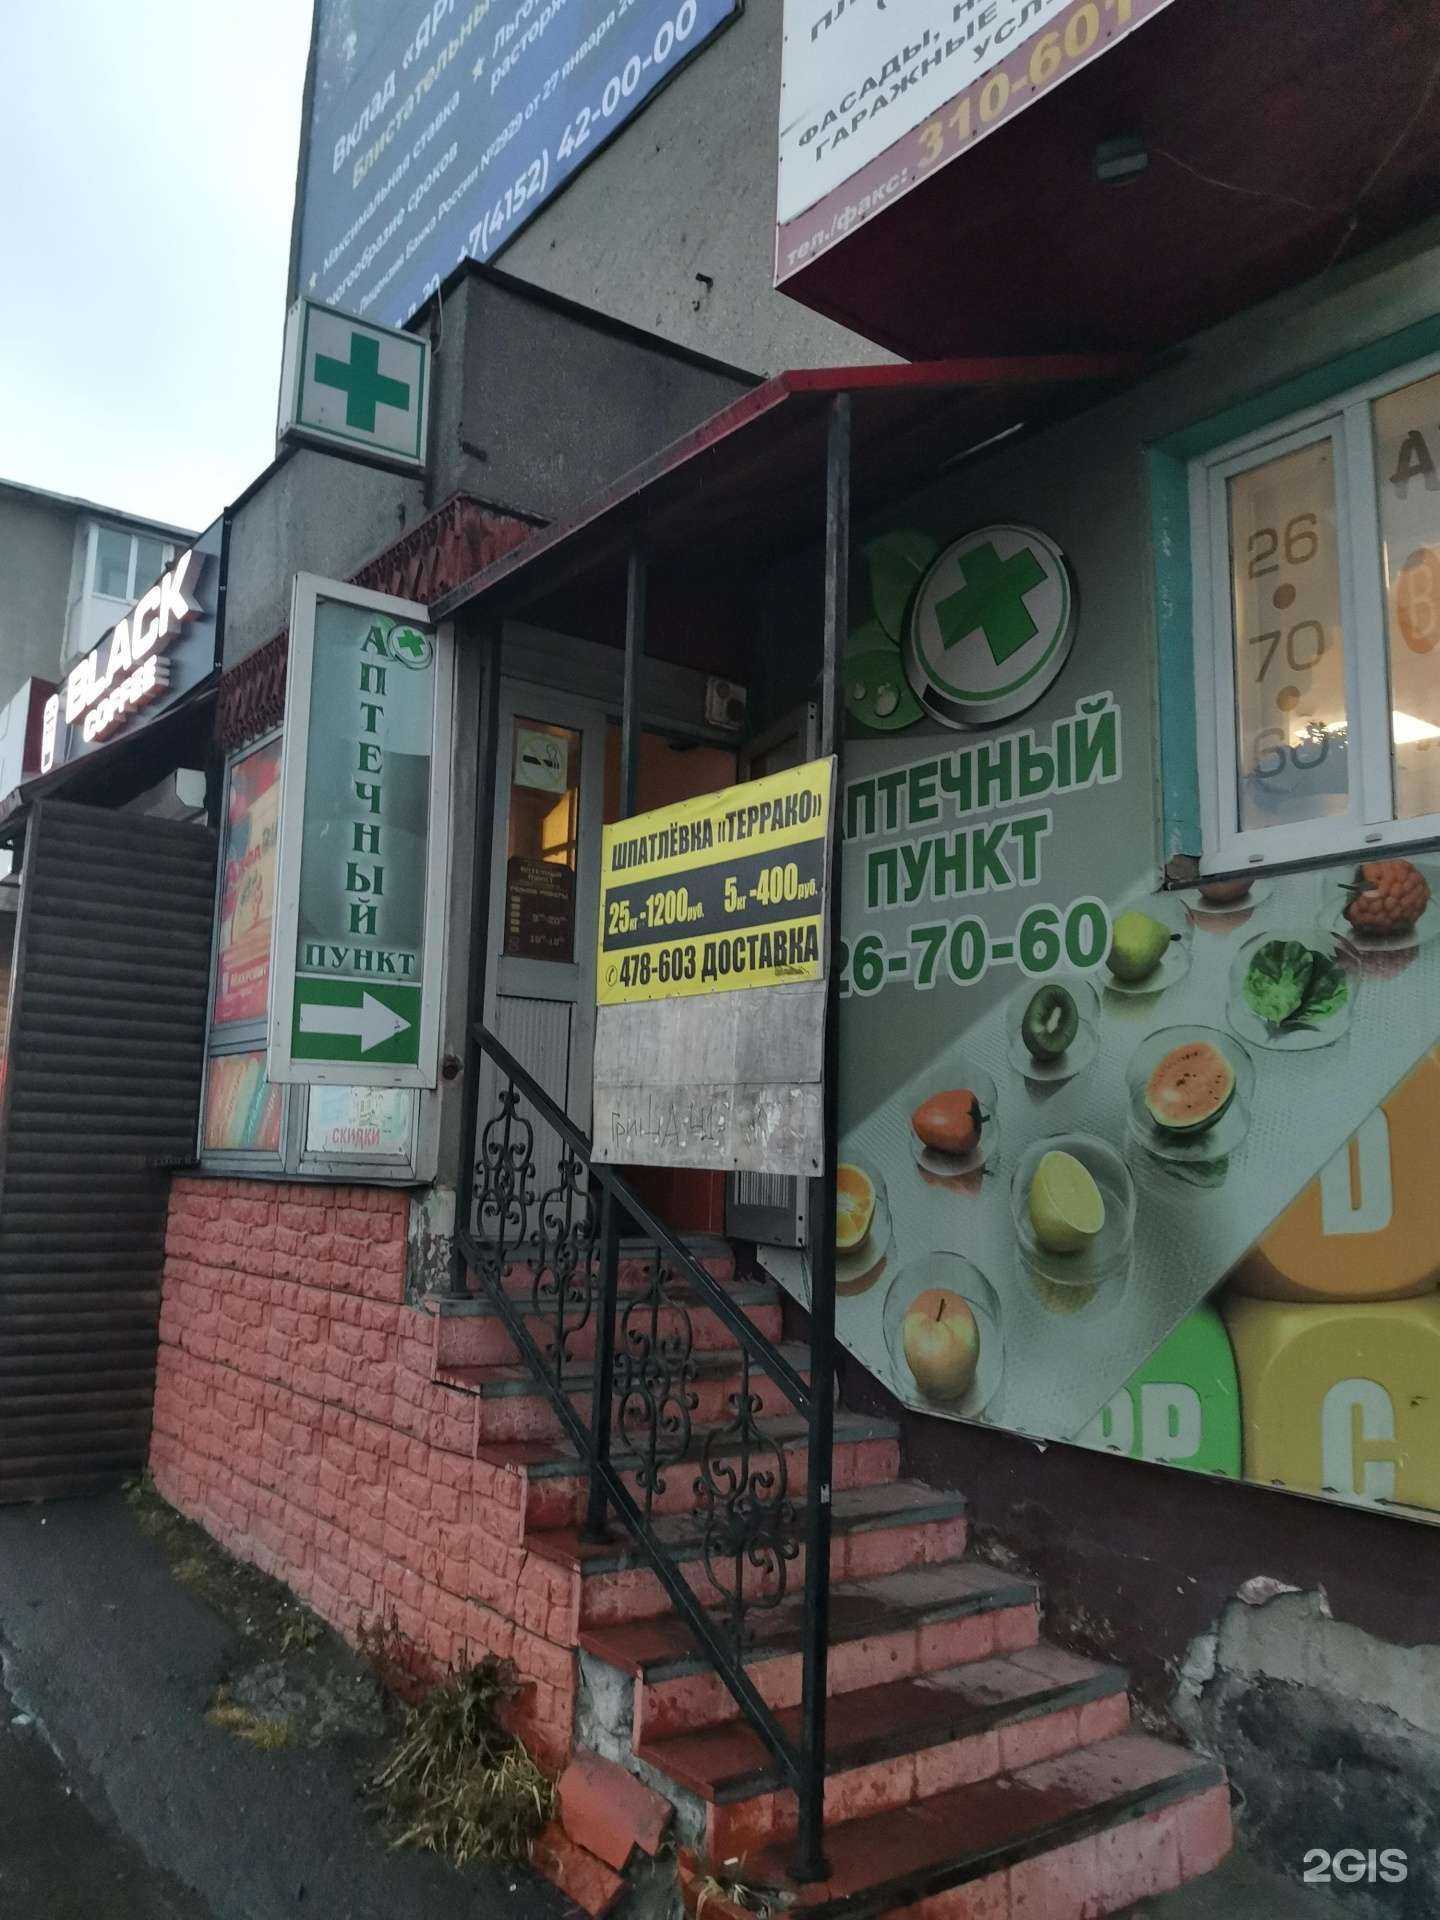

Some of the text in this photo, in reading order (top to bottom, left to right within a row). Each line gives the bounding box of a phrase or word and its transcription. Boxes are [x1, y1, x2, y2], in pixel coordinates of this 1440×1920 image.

[493, 0, 539, 58] Льго
[973, 0, 1054, 63] УСЛ
[353, 0, 491, 189] Блистательны
[525, 94, 541, 120] от
[557, 0, 698, 161] 42-00-00
[798, 28, 940, 146] ФАСАДЫ,
[815, 4, 997, 162] ГАРАЖНЫЕ
[333, 69, 397, 174] Вклад
[413, 90, 460, 159] ставка
[408, 142, 458, 213] сроков
[1247, 512, 1319, 579] 26
[66, 549, 193, 724] BLACK
[1249, 619, 1326, 683] 70
[83, 654, 158, 743] COFFEE
[344, 624, 390, 936] АПТЕЧНЫЙ
[842, 694, 1119, 840] ПТЕЧНЫЙ
[611, 817, 713, 872] ШПАТЛЁВКА
[867, 814, 1050, 910] ПУНКТ
[304, 942, 416, 976] ПУНКТ
[619, 924, 820, 988] 478-603 ДОСТАВКА
[331, 1126, 382, 1146] СКИДКИ
